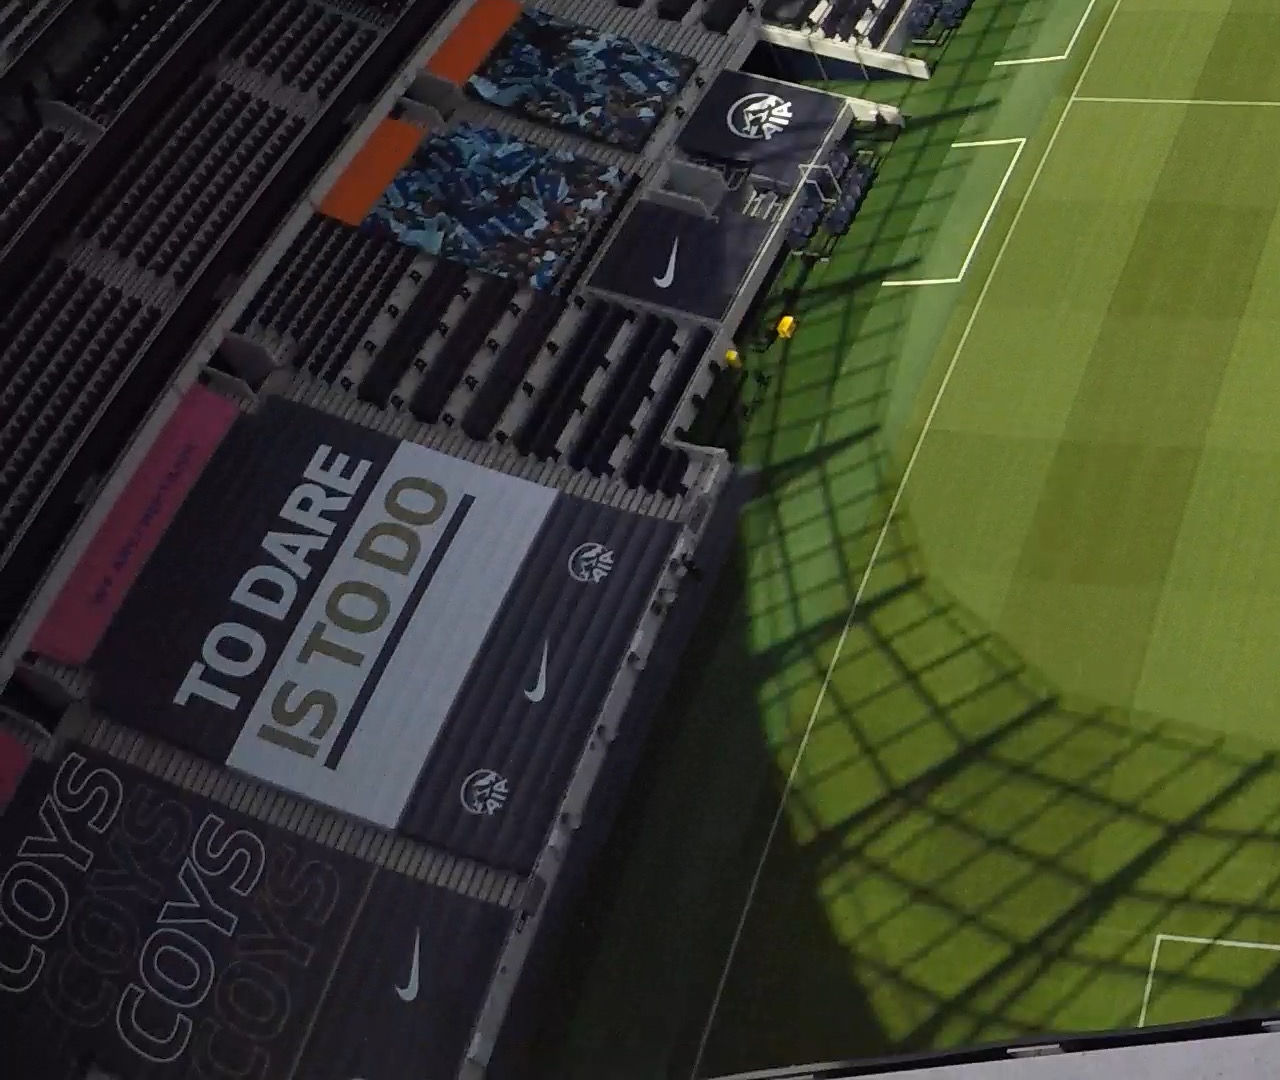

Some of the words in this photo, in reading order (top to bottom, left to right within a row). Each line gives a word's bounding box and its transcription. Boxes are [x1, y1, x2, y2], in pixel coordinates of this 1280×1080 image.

[761, 101, 793, 140] AIA
[353, 476, 448, 576] DO
[172, 621, 267, 711] TO
[229, 443, 374, 620] DARE
[296, 580, 391, 667] TO
[256, 680, 338, 758] IS
[116, 813, 266, 1063] COYS
